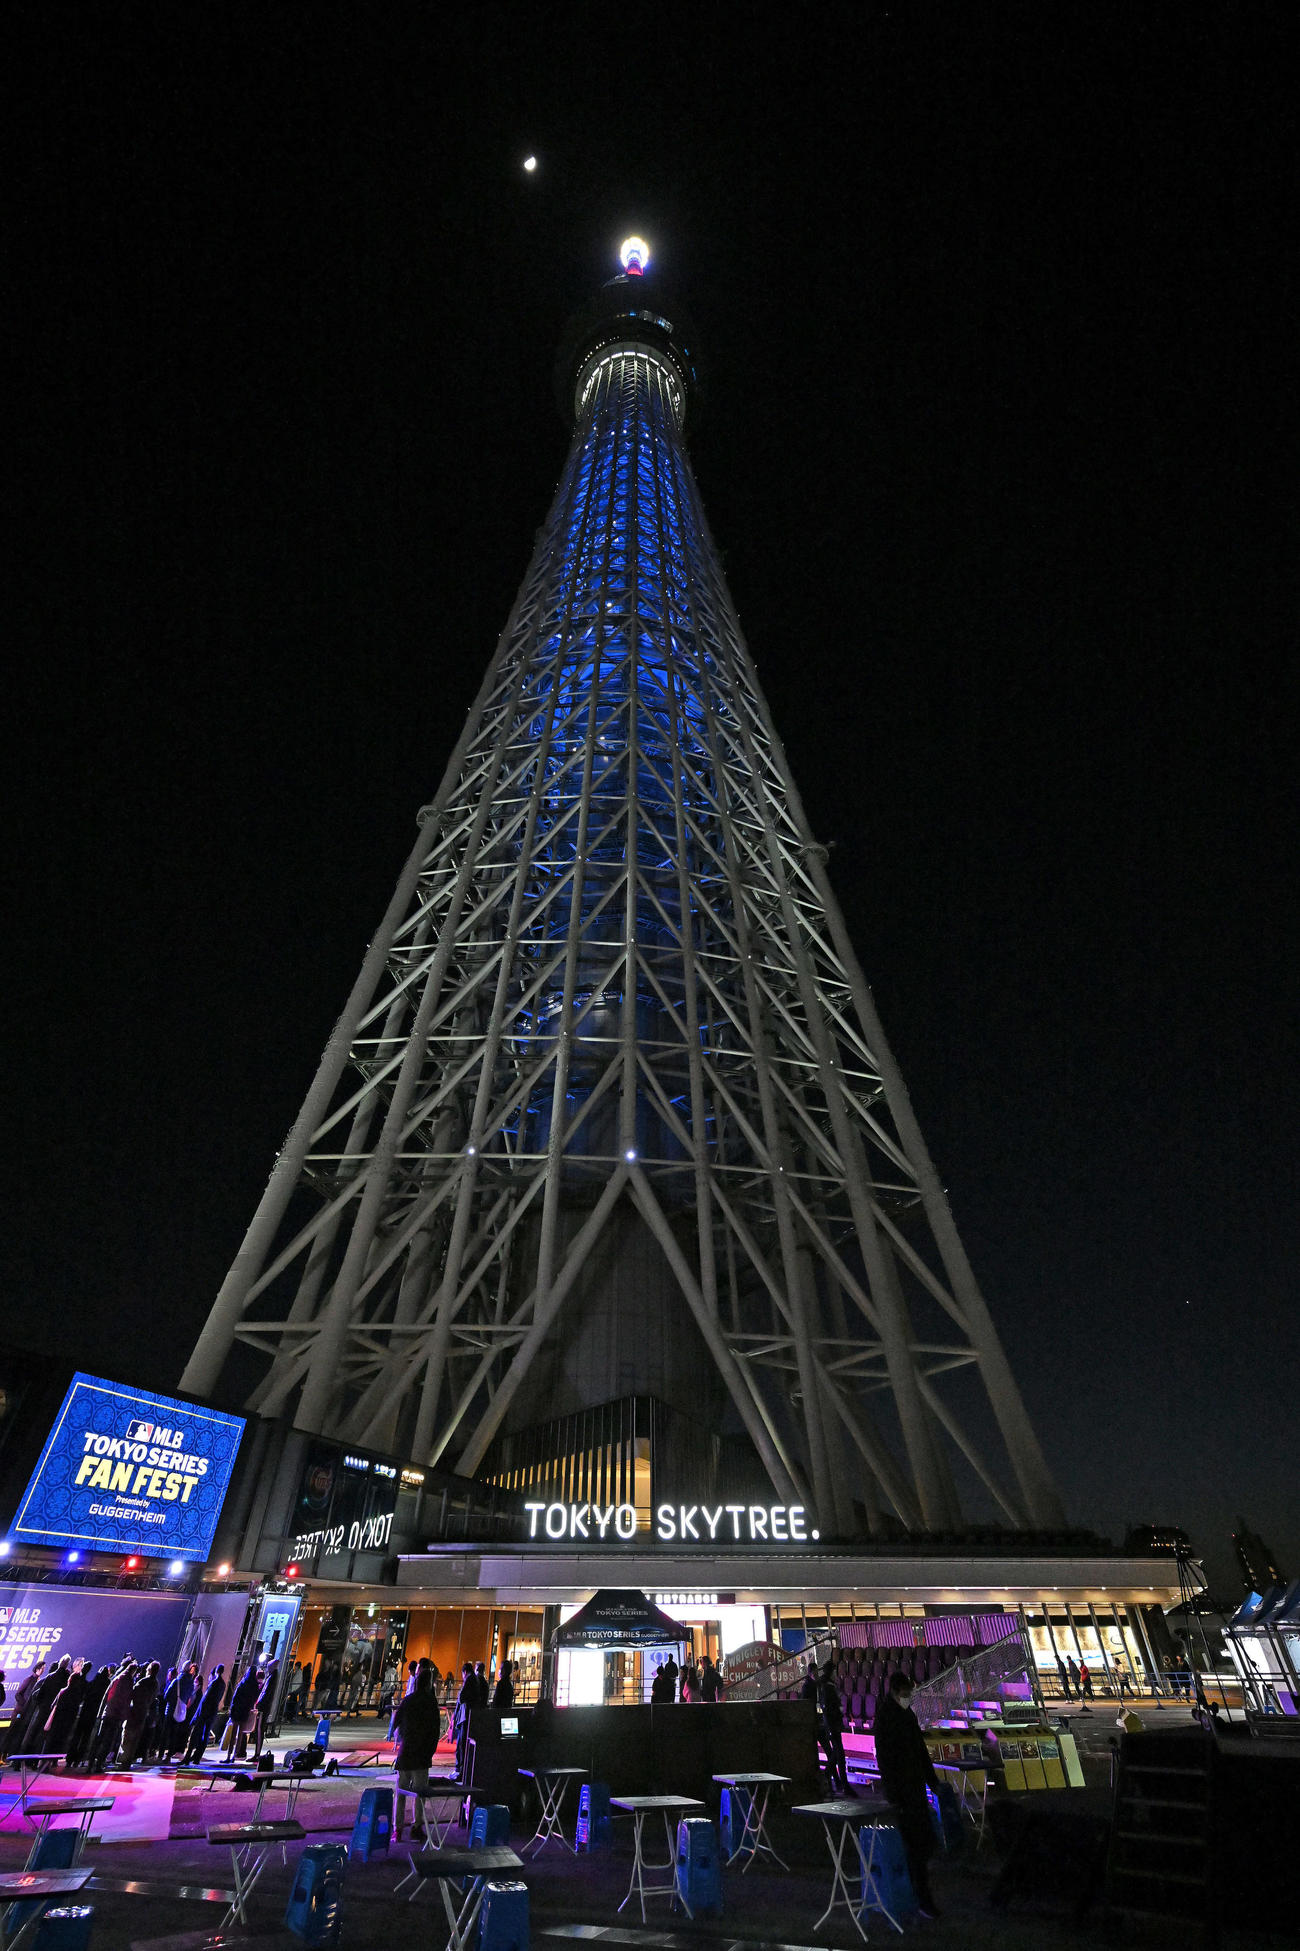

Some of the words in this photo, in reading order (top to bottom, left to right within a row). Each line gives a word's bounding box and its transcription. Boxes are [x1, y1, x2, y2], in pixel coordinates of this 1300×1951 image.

[151, 1426, 184, 1449] MLB
[83, 1432, 148, 1462] TOKYO
[146, 1447, 209, 1475] SERIES
[74, 1455, 135, 1492] FAN
[131, 1466, 199, 1503] FEST
[115, 1495, 142, 1506] Presented
[88, 1503, 166, 1524] GUGGENHEIM
[524, 1503, 637, 1539] TOKYO
[657, 1504, 820, 1540] SKYTREE.
[11, 1608, 41, 1624] MLB
[6, 1626, 63, 1643] SERIES
[587, 1631, 612, 1639] TOKYO
[613, 1630, 640, 1638] SERIES
[728, 1646, 765, 1668] WRIGLEY
